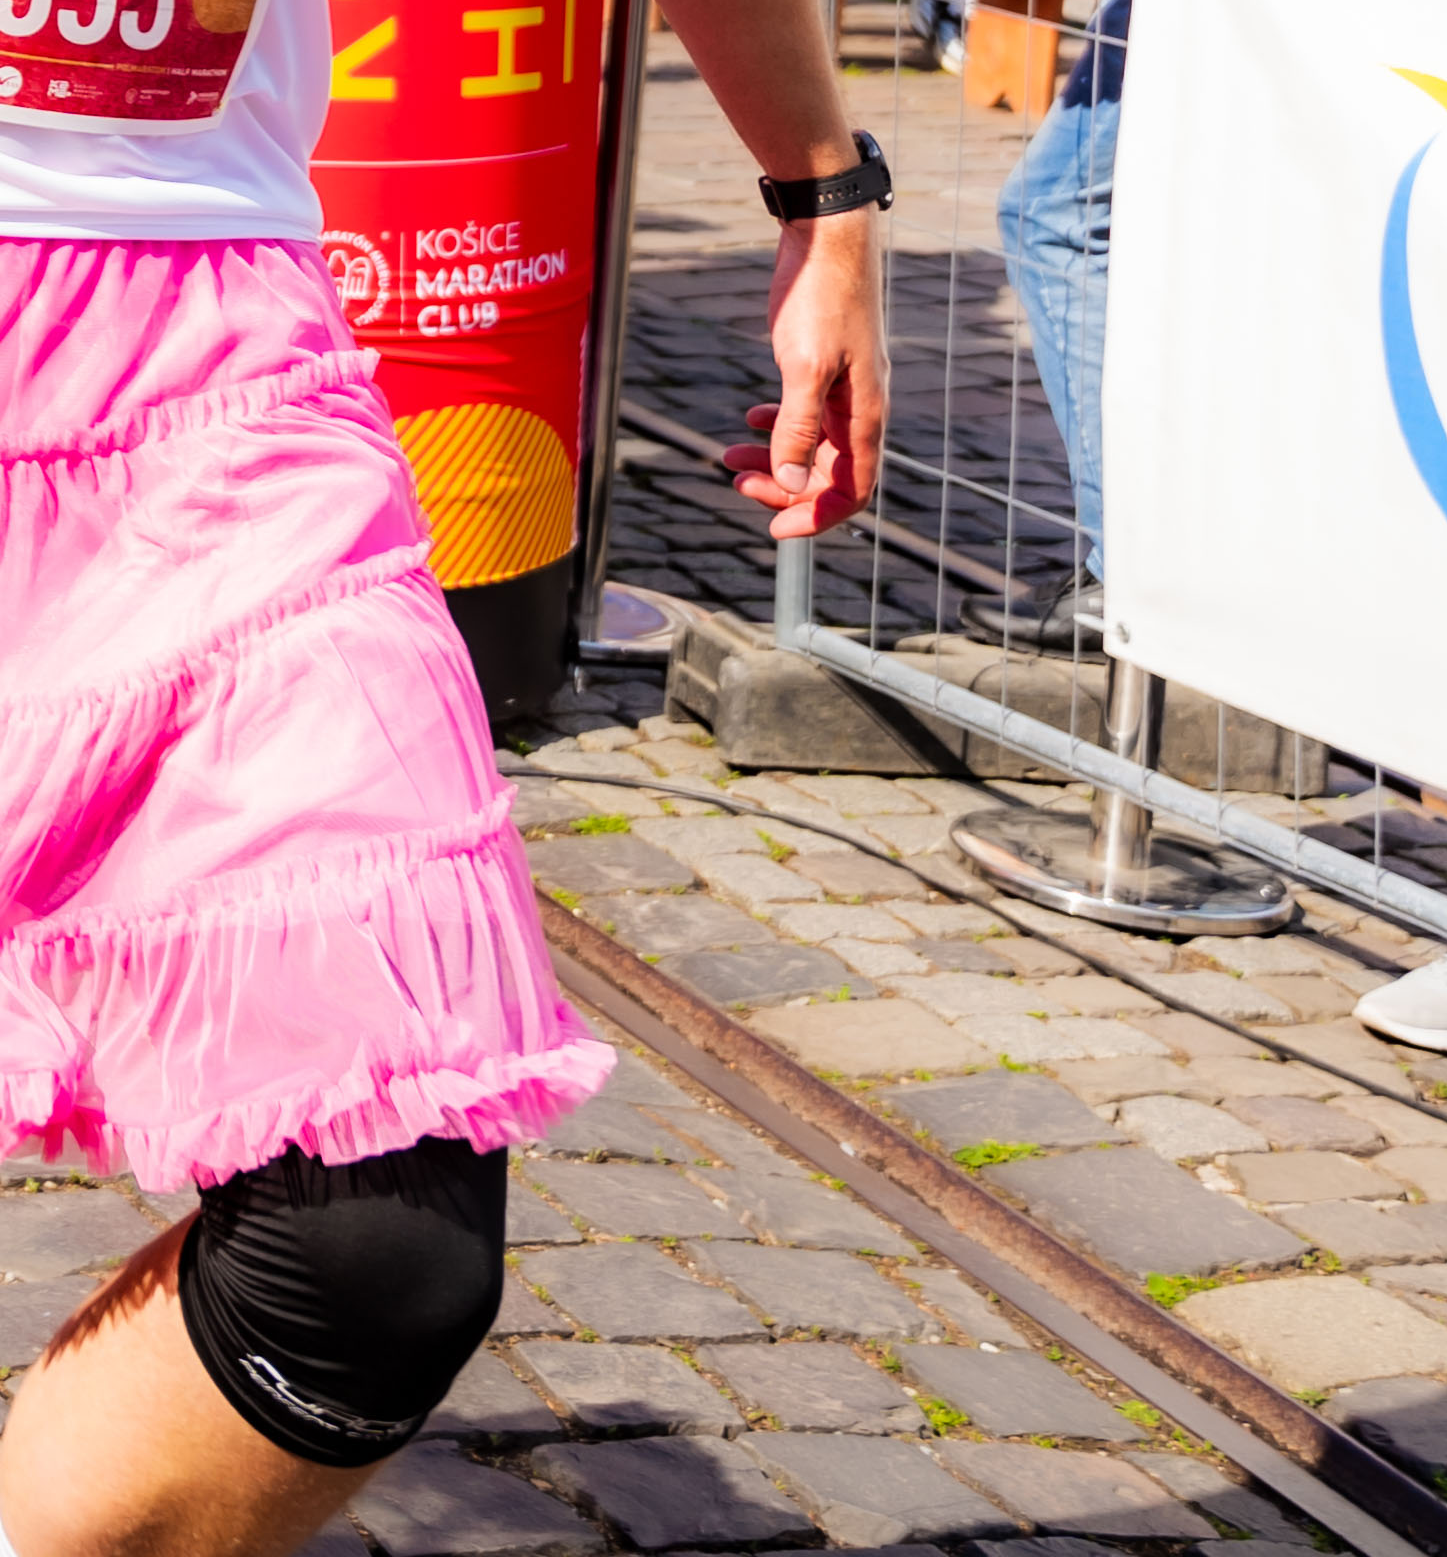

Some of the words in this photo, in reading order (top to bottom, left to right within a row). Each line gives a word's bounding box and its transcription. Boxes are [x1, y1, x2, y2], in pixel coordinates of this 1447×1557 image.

[416, 220, 520, 260] KOŠICE
[415, 249, 567, 300] MARATHON
[417, 301, 501, 337] CLUB
